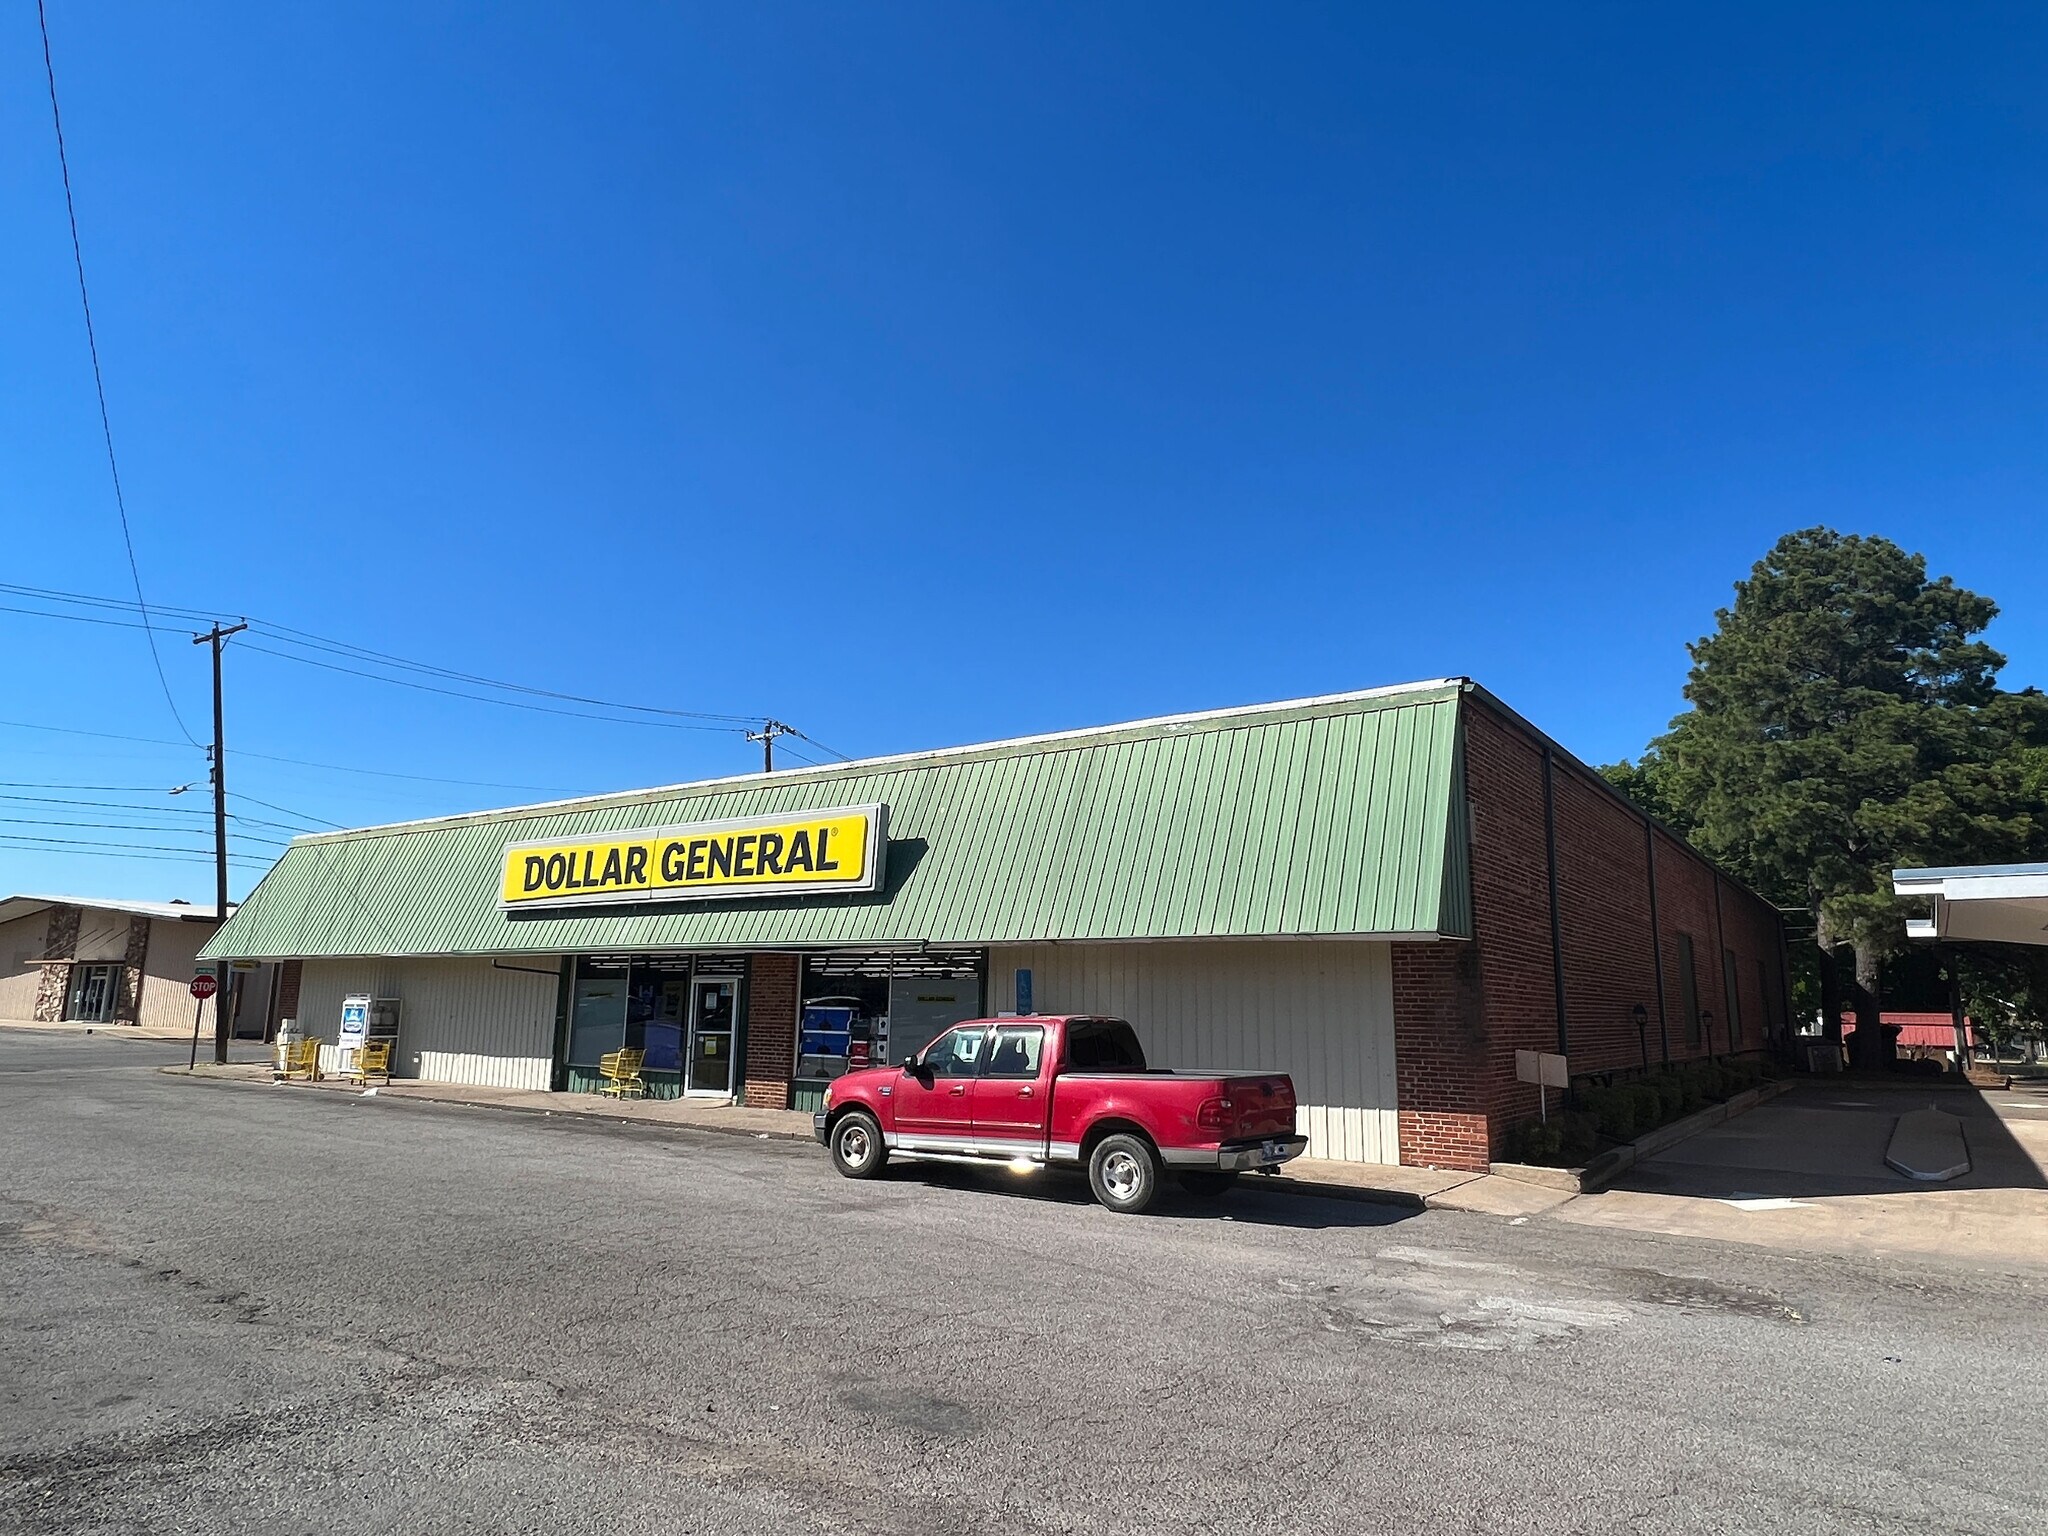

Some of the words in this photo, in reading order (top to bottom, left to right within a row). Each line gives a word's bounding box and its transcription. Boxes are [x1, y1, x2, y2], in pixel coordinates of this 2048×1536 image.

[524, 846, 647, 892] DOLLAR
[661, 828, 838, 882] GENERAL
[192, 982, 216, 992] STOP
